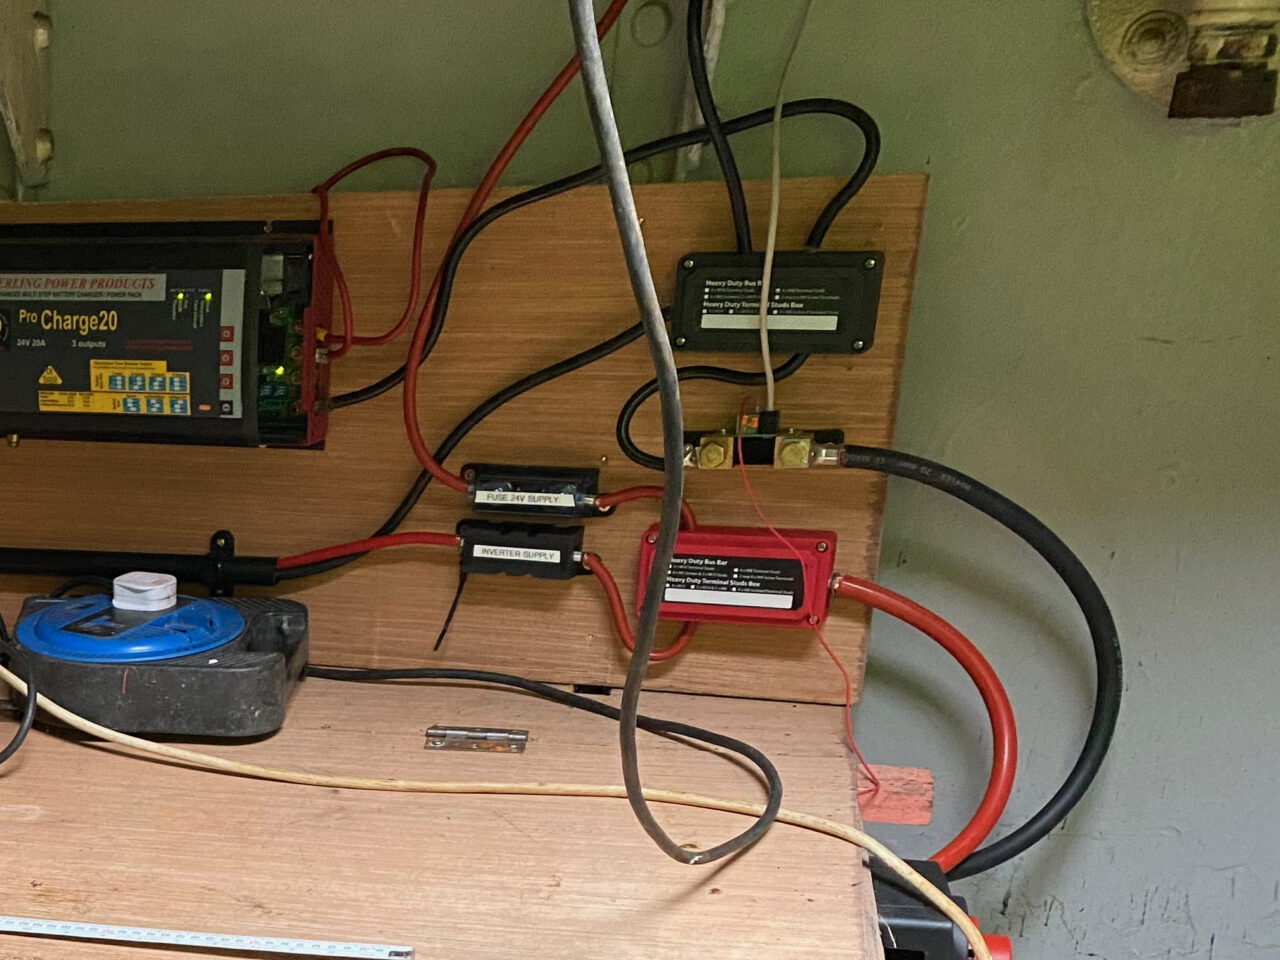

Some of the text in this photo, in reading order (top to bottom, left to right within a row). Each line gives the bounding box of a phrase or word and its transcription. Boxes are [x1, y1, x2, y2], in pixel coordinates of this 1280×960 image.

[44, 277, 87, 289] POWER
[90, 277, 155, 290] PRODUCTS
[19, 309, 37, 323] Pro
[41, 309, 118, 336] Charge20
[78, 340, 106, 348] outputs
[481, 548, 555, 560] INVERTER SUPPLY
[689, 558, 704, 566] Duty
[666, 576, 685, 584] Heavy
[686, 577, 702, 585] Duty
